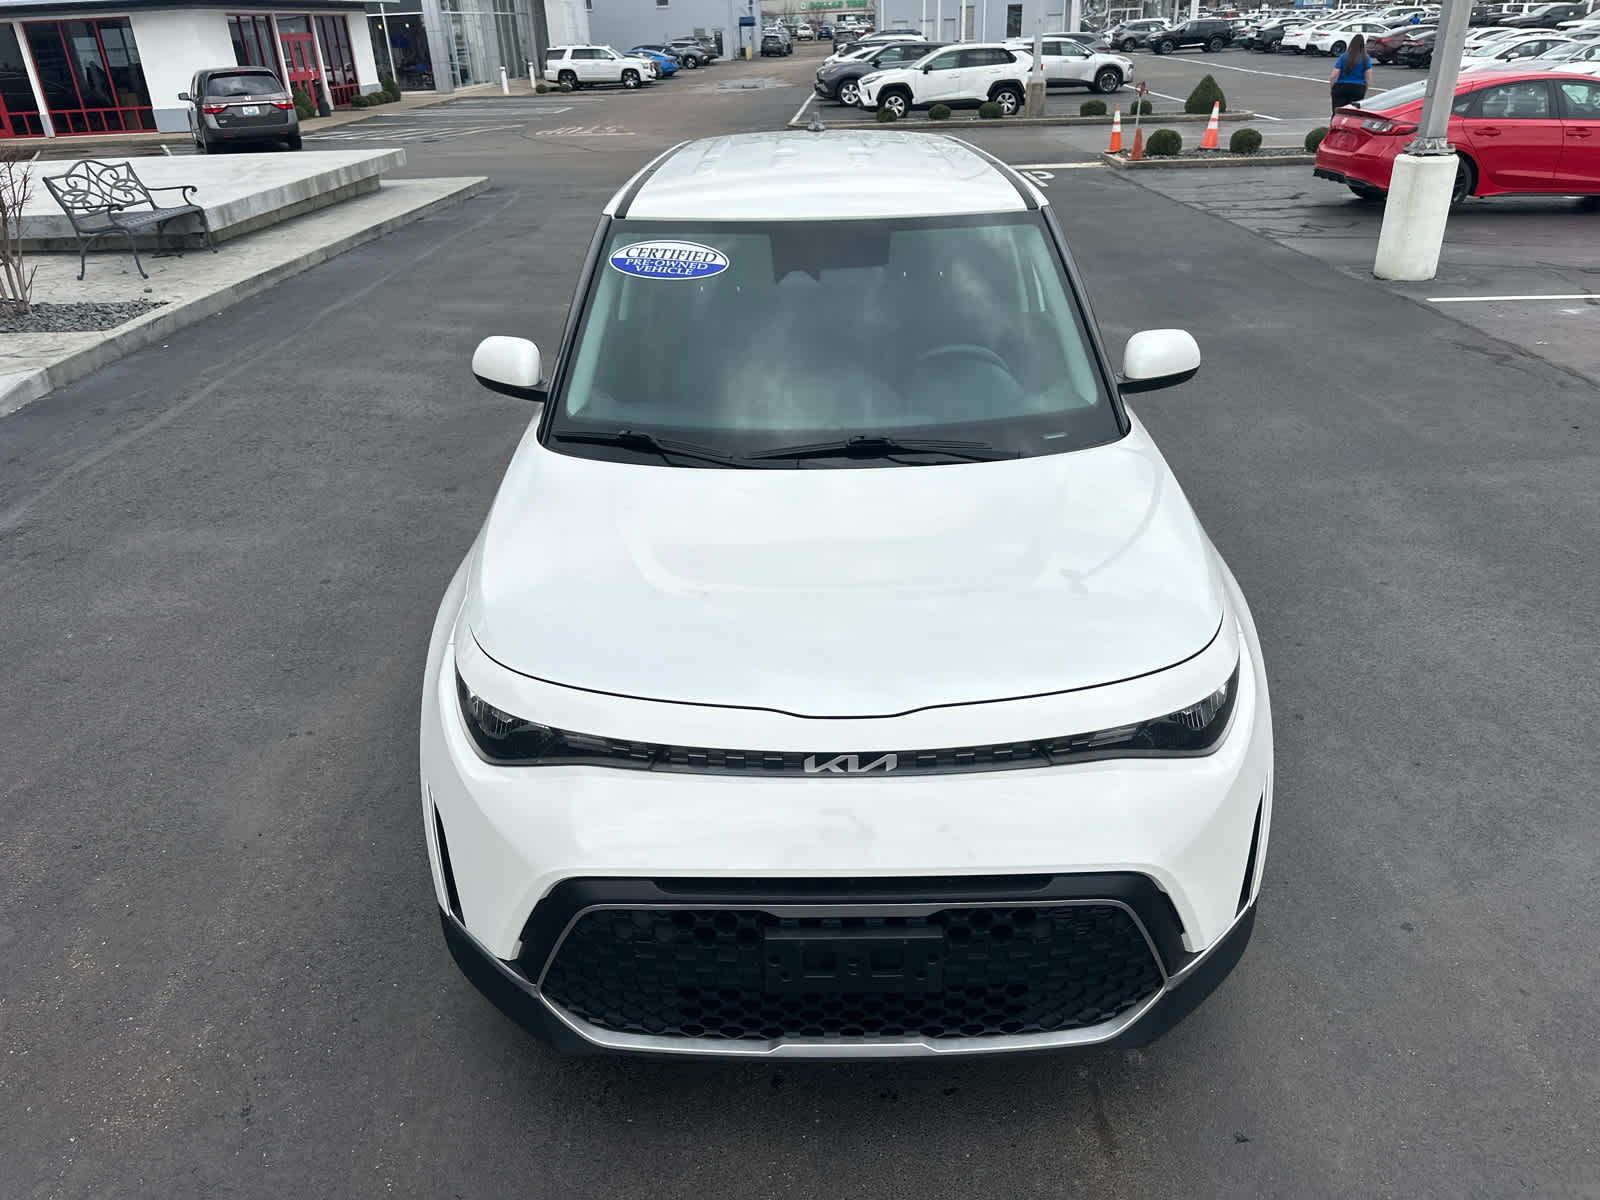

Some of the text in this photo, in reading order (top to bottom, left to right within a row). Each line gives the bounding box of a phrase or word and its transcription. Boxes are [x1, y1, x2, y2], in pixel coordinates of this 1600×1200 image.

[626, 247, 718, 263] CERTIFIED
[625, 258, 709, 270] PRE-OWNED
[635, 265, 693, 276] VEHICLE
